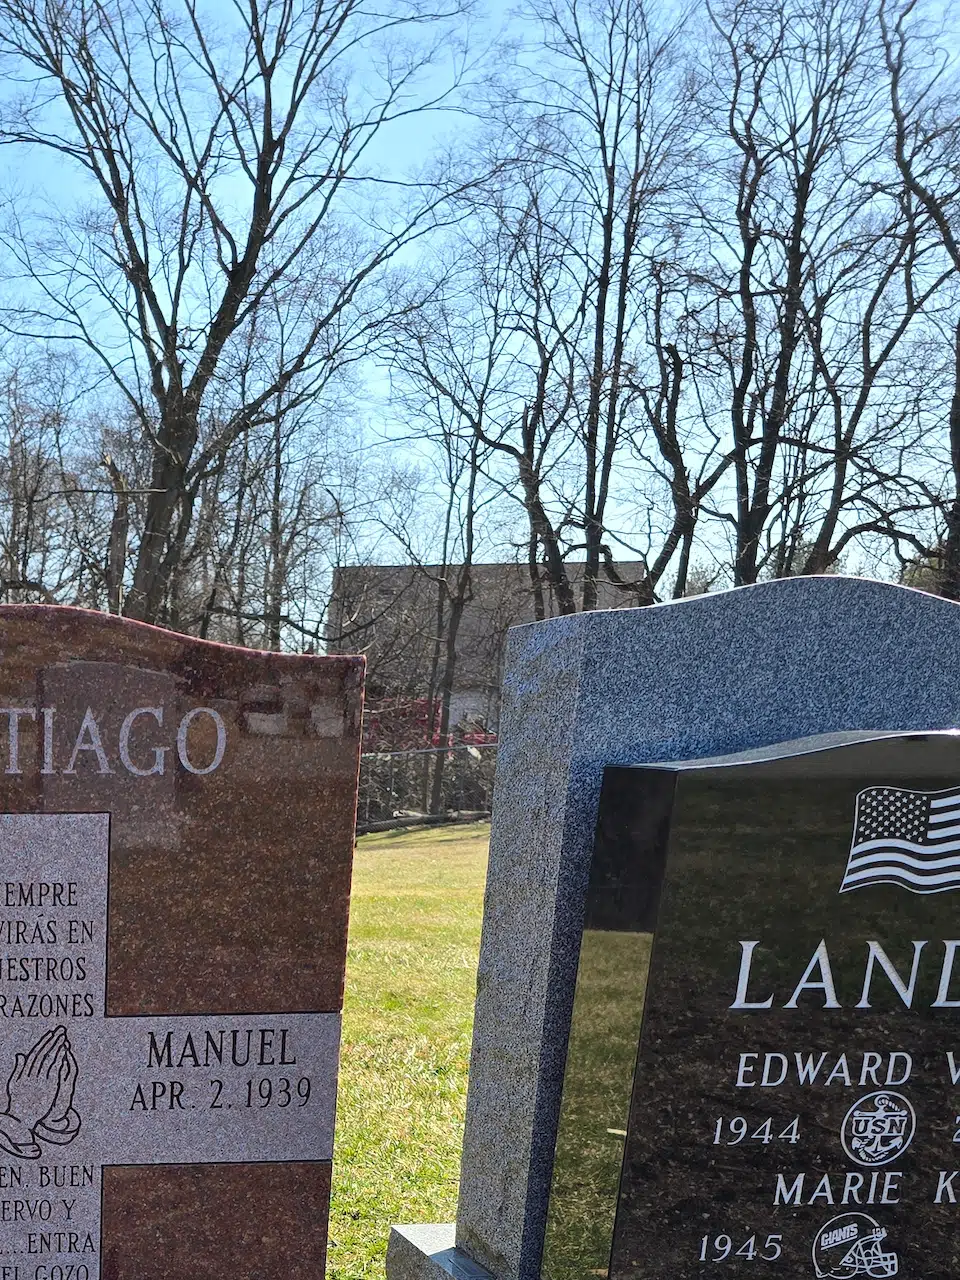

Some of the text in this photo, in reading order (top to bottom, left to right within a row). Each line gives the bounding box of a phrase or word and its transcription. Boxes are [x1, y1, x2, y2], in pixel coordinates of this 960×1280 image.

[68, 920, 94, 944] EN
[146, 1028, 297, 1068] MANUEL
[734, 1051, 913, 1087] EDWARD
[129, 1081, 196, 1111] APR.
[245, 1077, 312, 1108] 1939
[712, 1116, 802, 1145] 1944
[853, 1117, 907, 1136] USN
[39, 1165, 94, 1187] BUEN
[772, 1171, 904, 1206] MARIE
[61, 1200, 77, 1220] Y
[698, 1234, 783, 1262] 1945
[820, 1222, 859, 1248] GIANTS
